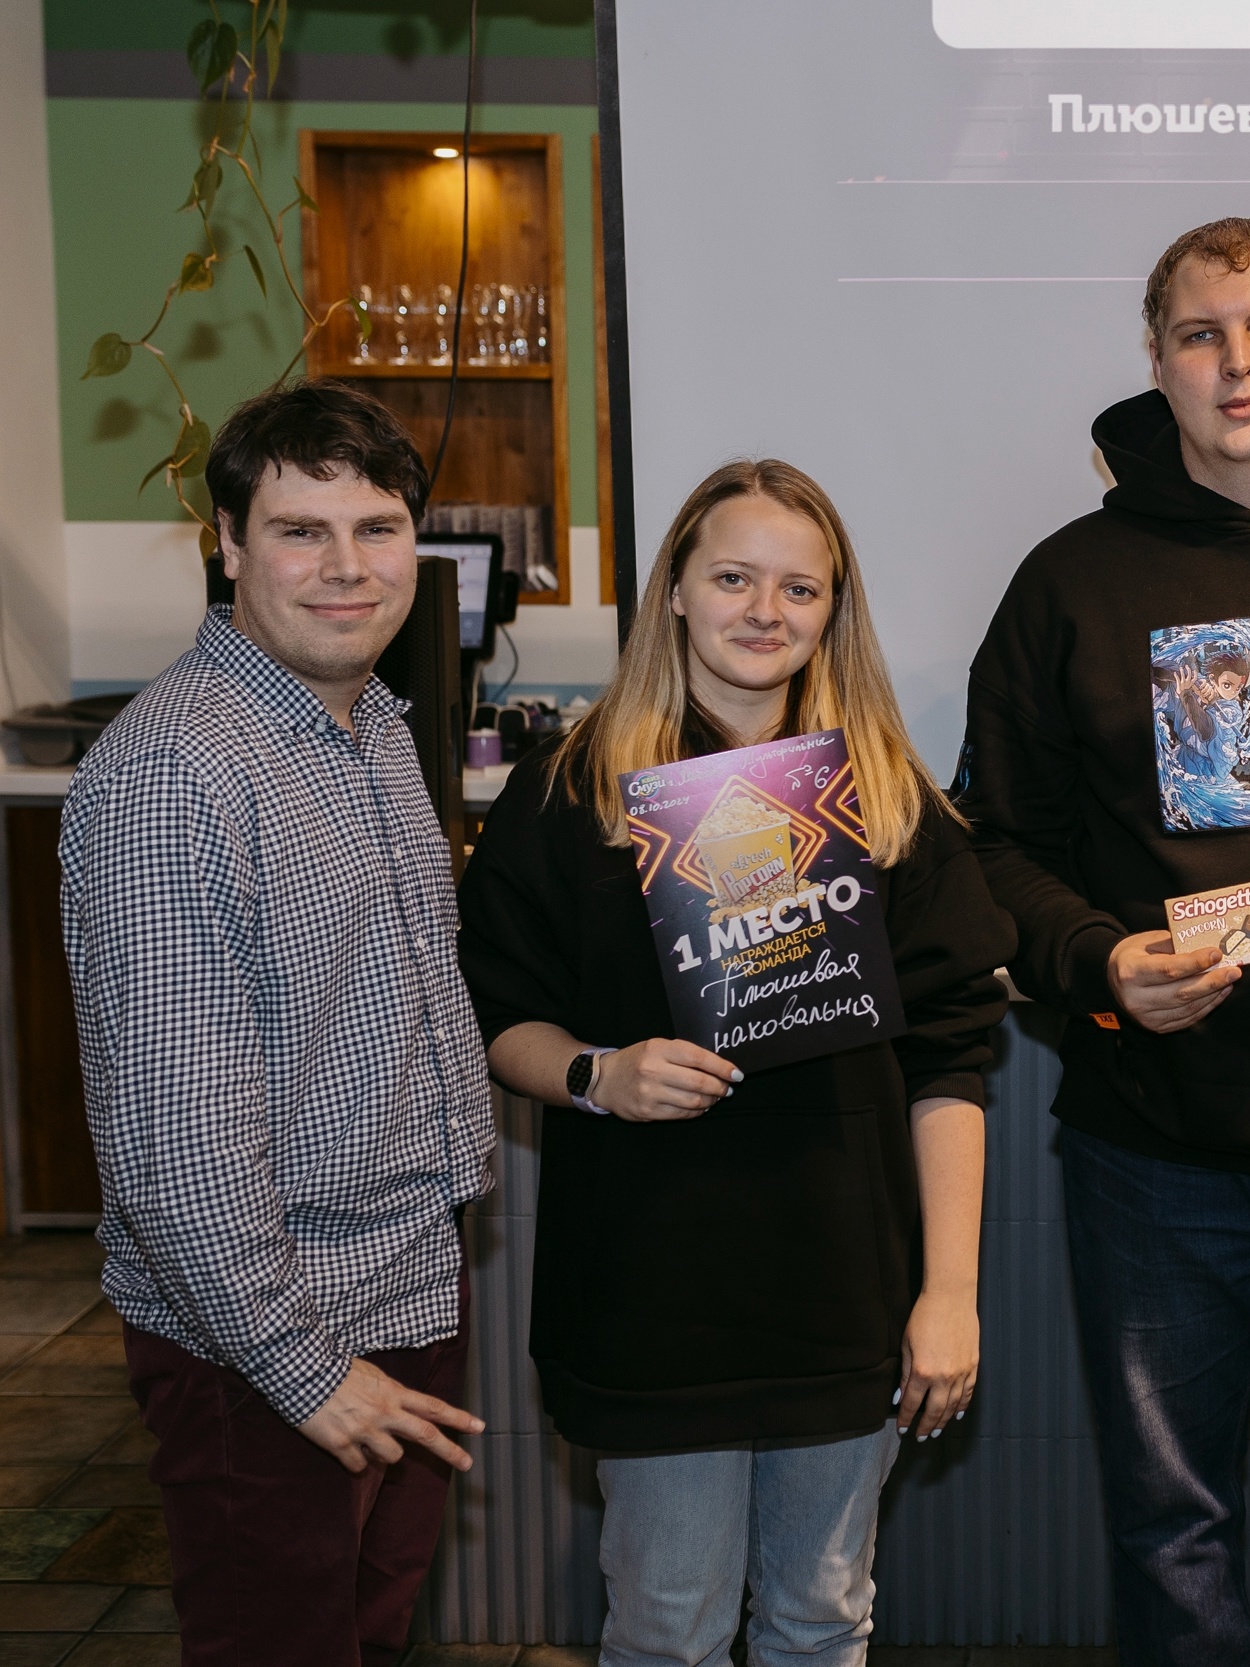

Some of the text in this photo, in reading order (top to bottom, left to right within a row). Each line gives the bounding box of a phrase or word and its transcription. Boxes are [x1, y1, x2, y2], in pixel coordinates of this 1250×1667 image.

[628, 779, 666, 796] Смузи
[673, 875, 861, 972] 1 МЕСТО
[721, 922, 827, 971] НАГРАЖДАЕТСЯ
[1177, 917, 1227, 943] POPCORN
[701, 949, 862, 1018] Плюшевая
[743, 946, 812, 977] КОМАНДА
[714, 995, 880, 1054] наковальня
